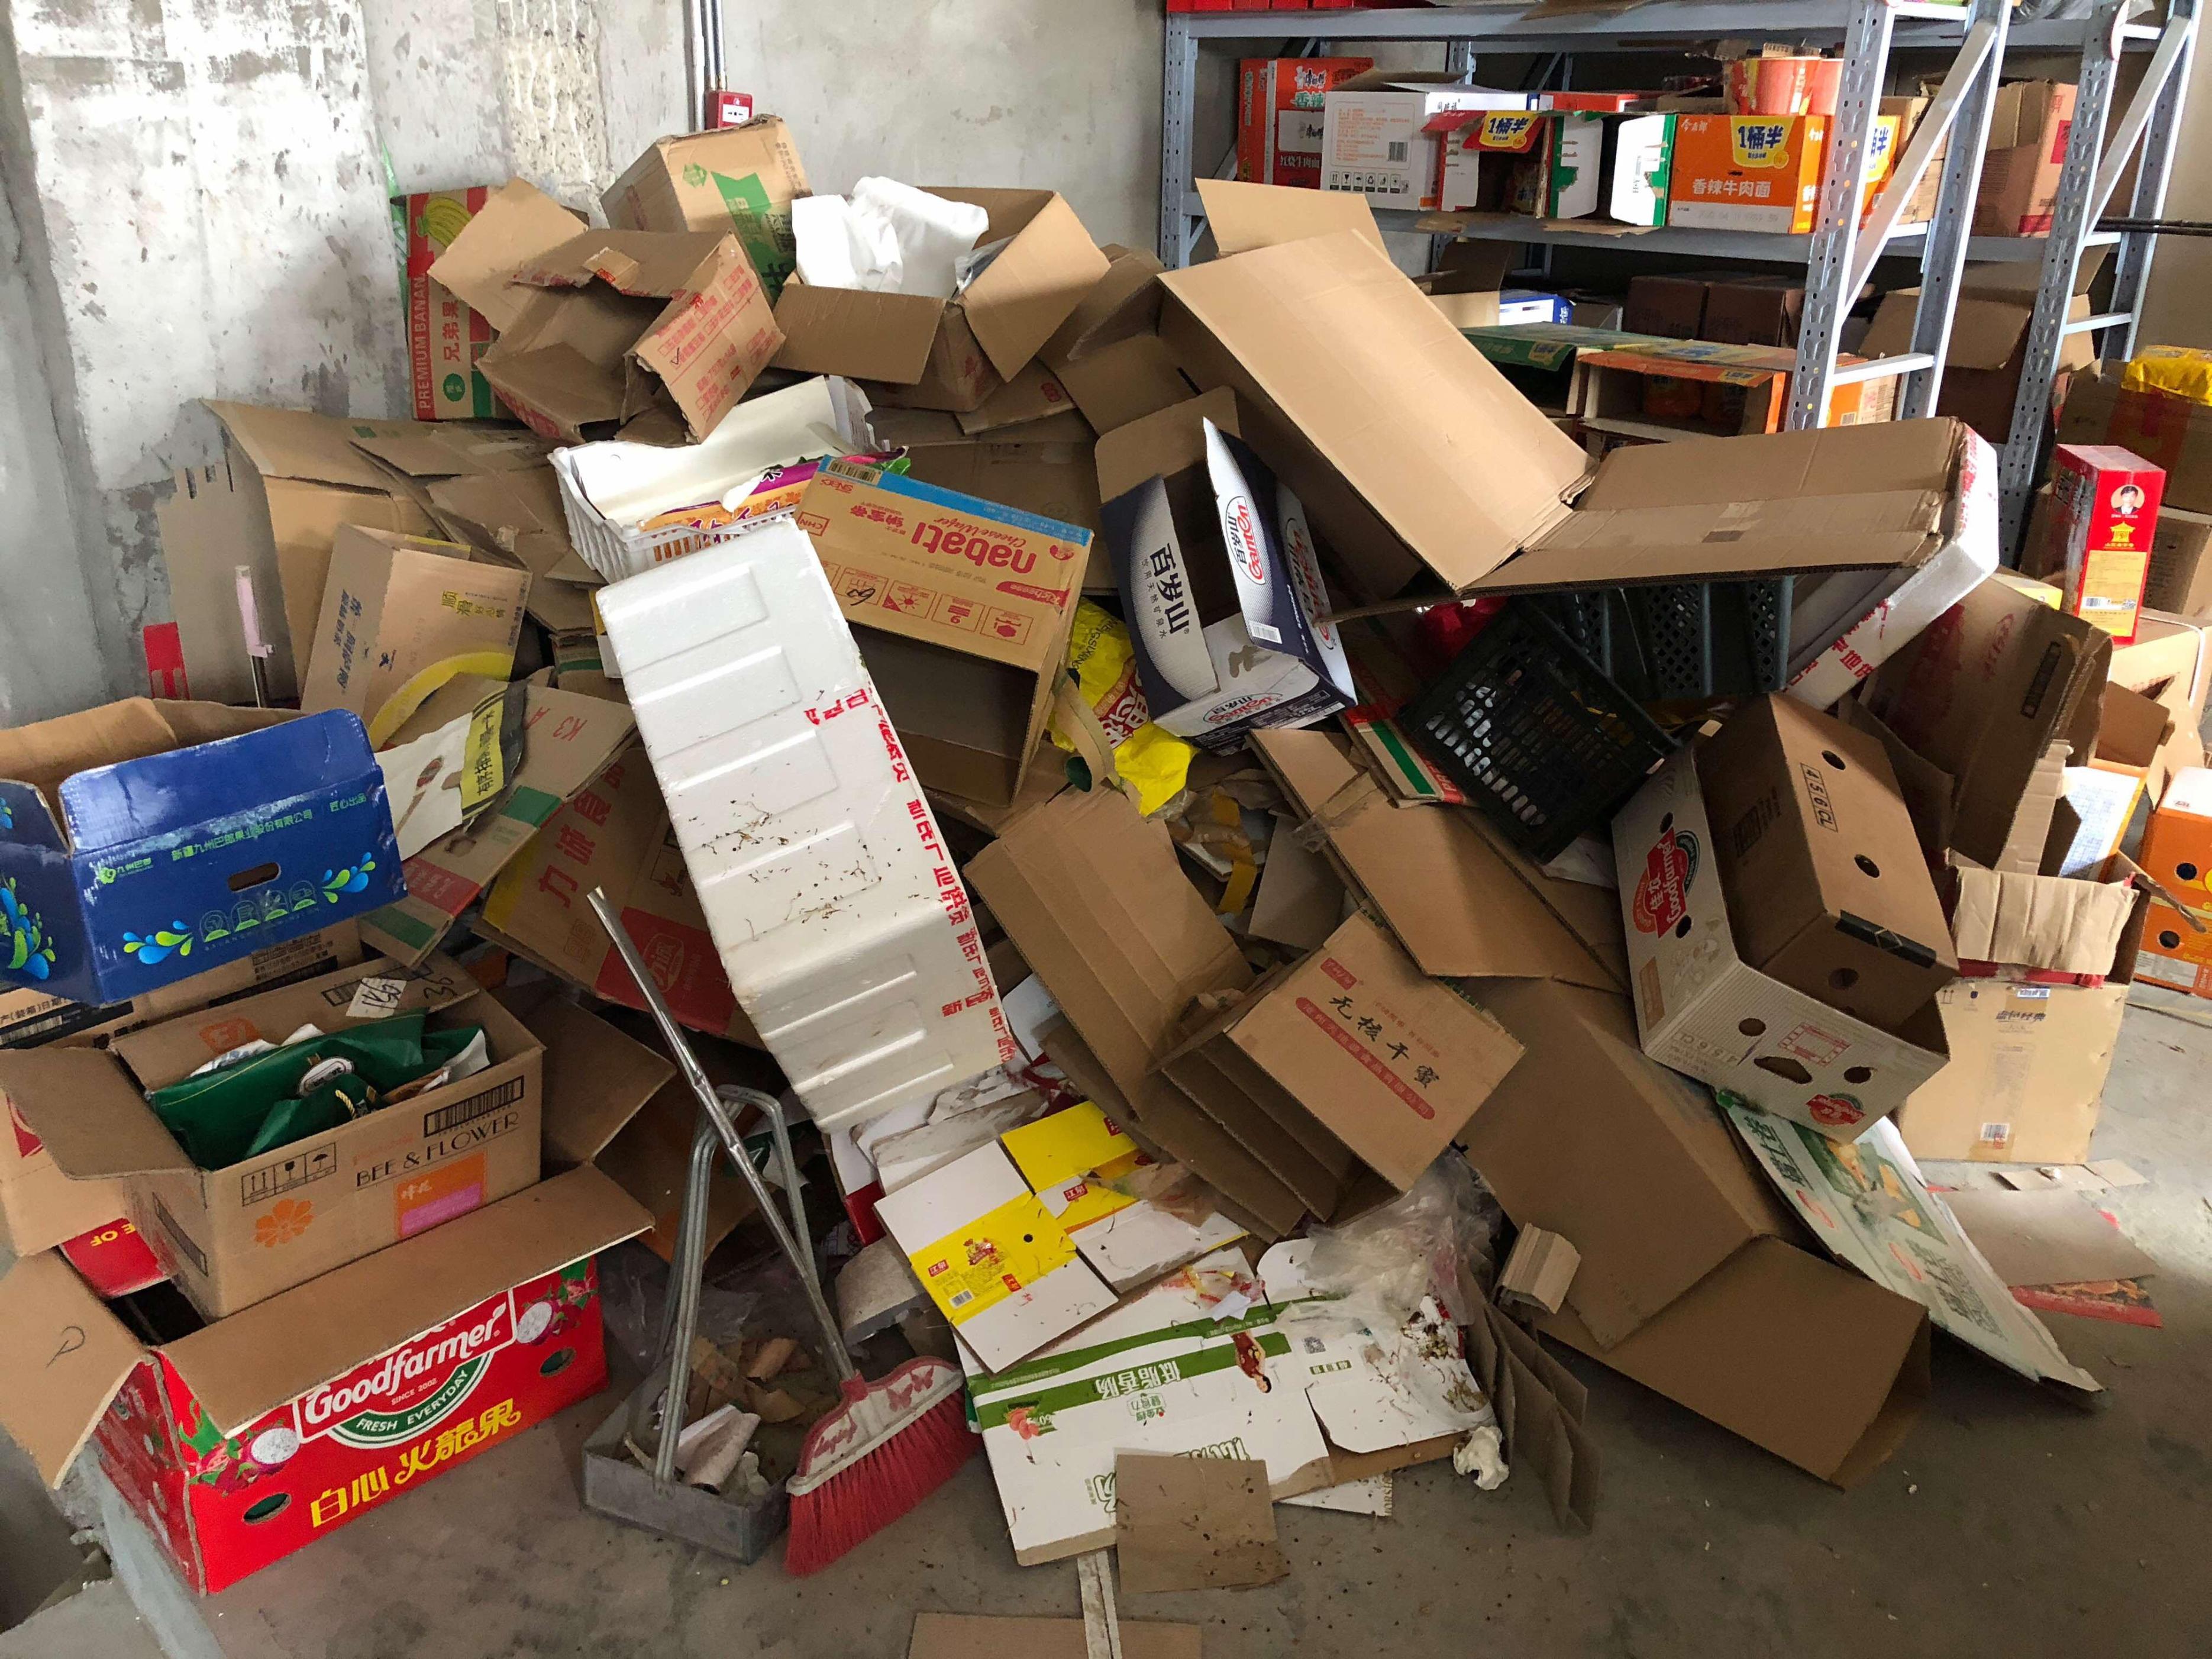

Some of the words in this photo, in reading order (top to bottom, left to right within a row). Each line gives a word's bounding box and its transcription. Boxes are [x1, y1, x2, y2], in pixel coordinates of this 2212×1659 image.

[1488, 117, 1529, 135] 1桶半
[1738, 124, 1784, 150] 1桶半
[1692, 179, 1772, 199] 香辣牛肉面
[414, 273, 427, 331] BANAN
[443, 286, 460, 362] 兄弟果
[416, 336, 431, 409] PREMIUM
[800, 519, 824, 530] CHN
[934, 517, 981, 537] Wafer
[981, 528, 1026, 548] Cheese
[1228, 514, 1247, 564] 百岁山
[1237, 504, 1263, 580] Ganten
[912, 522, 1037, 574] nabati
[1009, 583, 1062, 605] Richeese
[1149, 543, 1189, 634] 百岁山
[1650, 840, 1688, 923] Goodfarmer
[356, 1158, 391, 1187] BEE
[402, 1150, 421, 1169] &
[426, 1111, 521, 1161] FLOWER
[90, 1230, 118, 1248] OF
[121, 1222, 135, 1235] E
[304, 1305, 498, 1426] Goodfarmer
[1094, 1360, 1182, 1400] 低脂香肠
[356, 1416, 398, 1433] FRESH
[406, 1368, 471, 1425] EVERYDAY
[391, 1388, 415, 1406] SINCE
[417, 1377, 438, 1393] 2002
